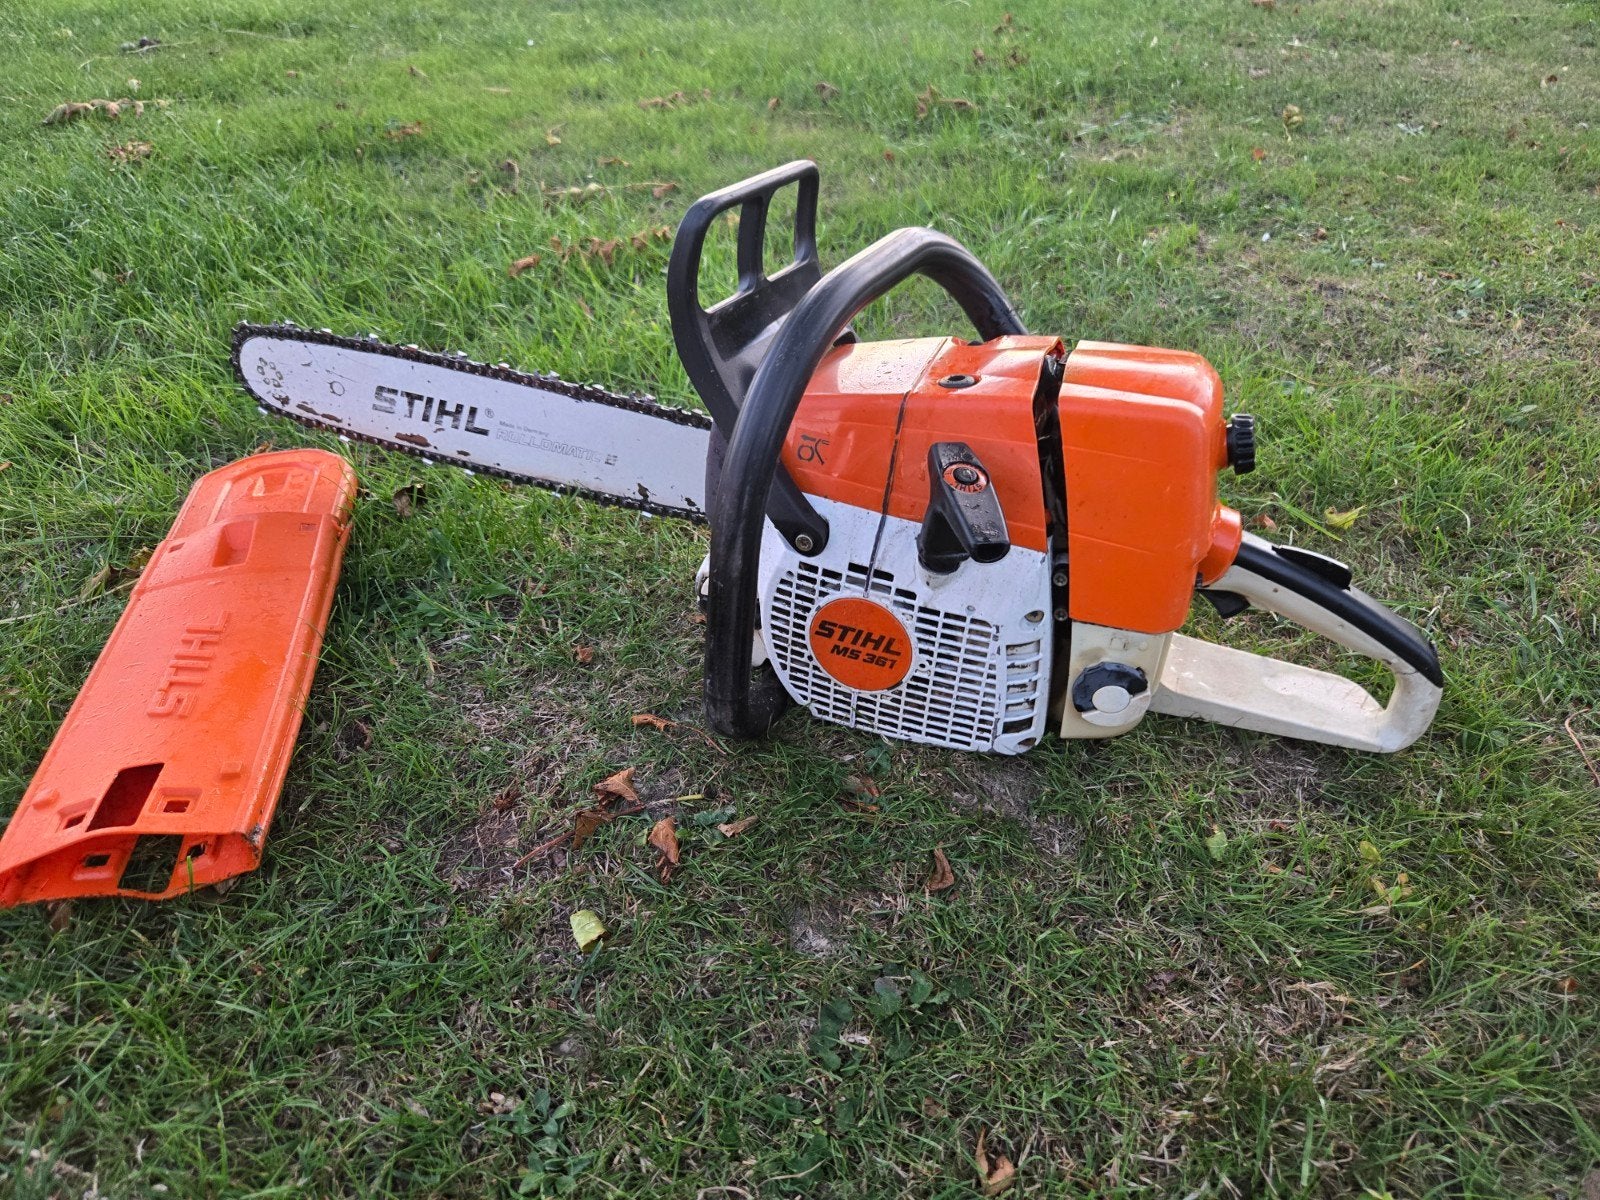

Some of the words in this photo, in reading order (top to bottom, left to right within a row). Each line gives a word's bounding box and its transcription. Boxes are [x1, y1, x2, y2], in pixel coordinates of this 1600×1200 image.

[815, 620, 902, 656] STIHL
[147, 611, 230, 719] STIHL
[830, 644, 862, 660] MS
[862, 653, 897, 670] 361
